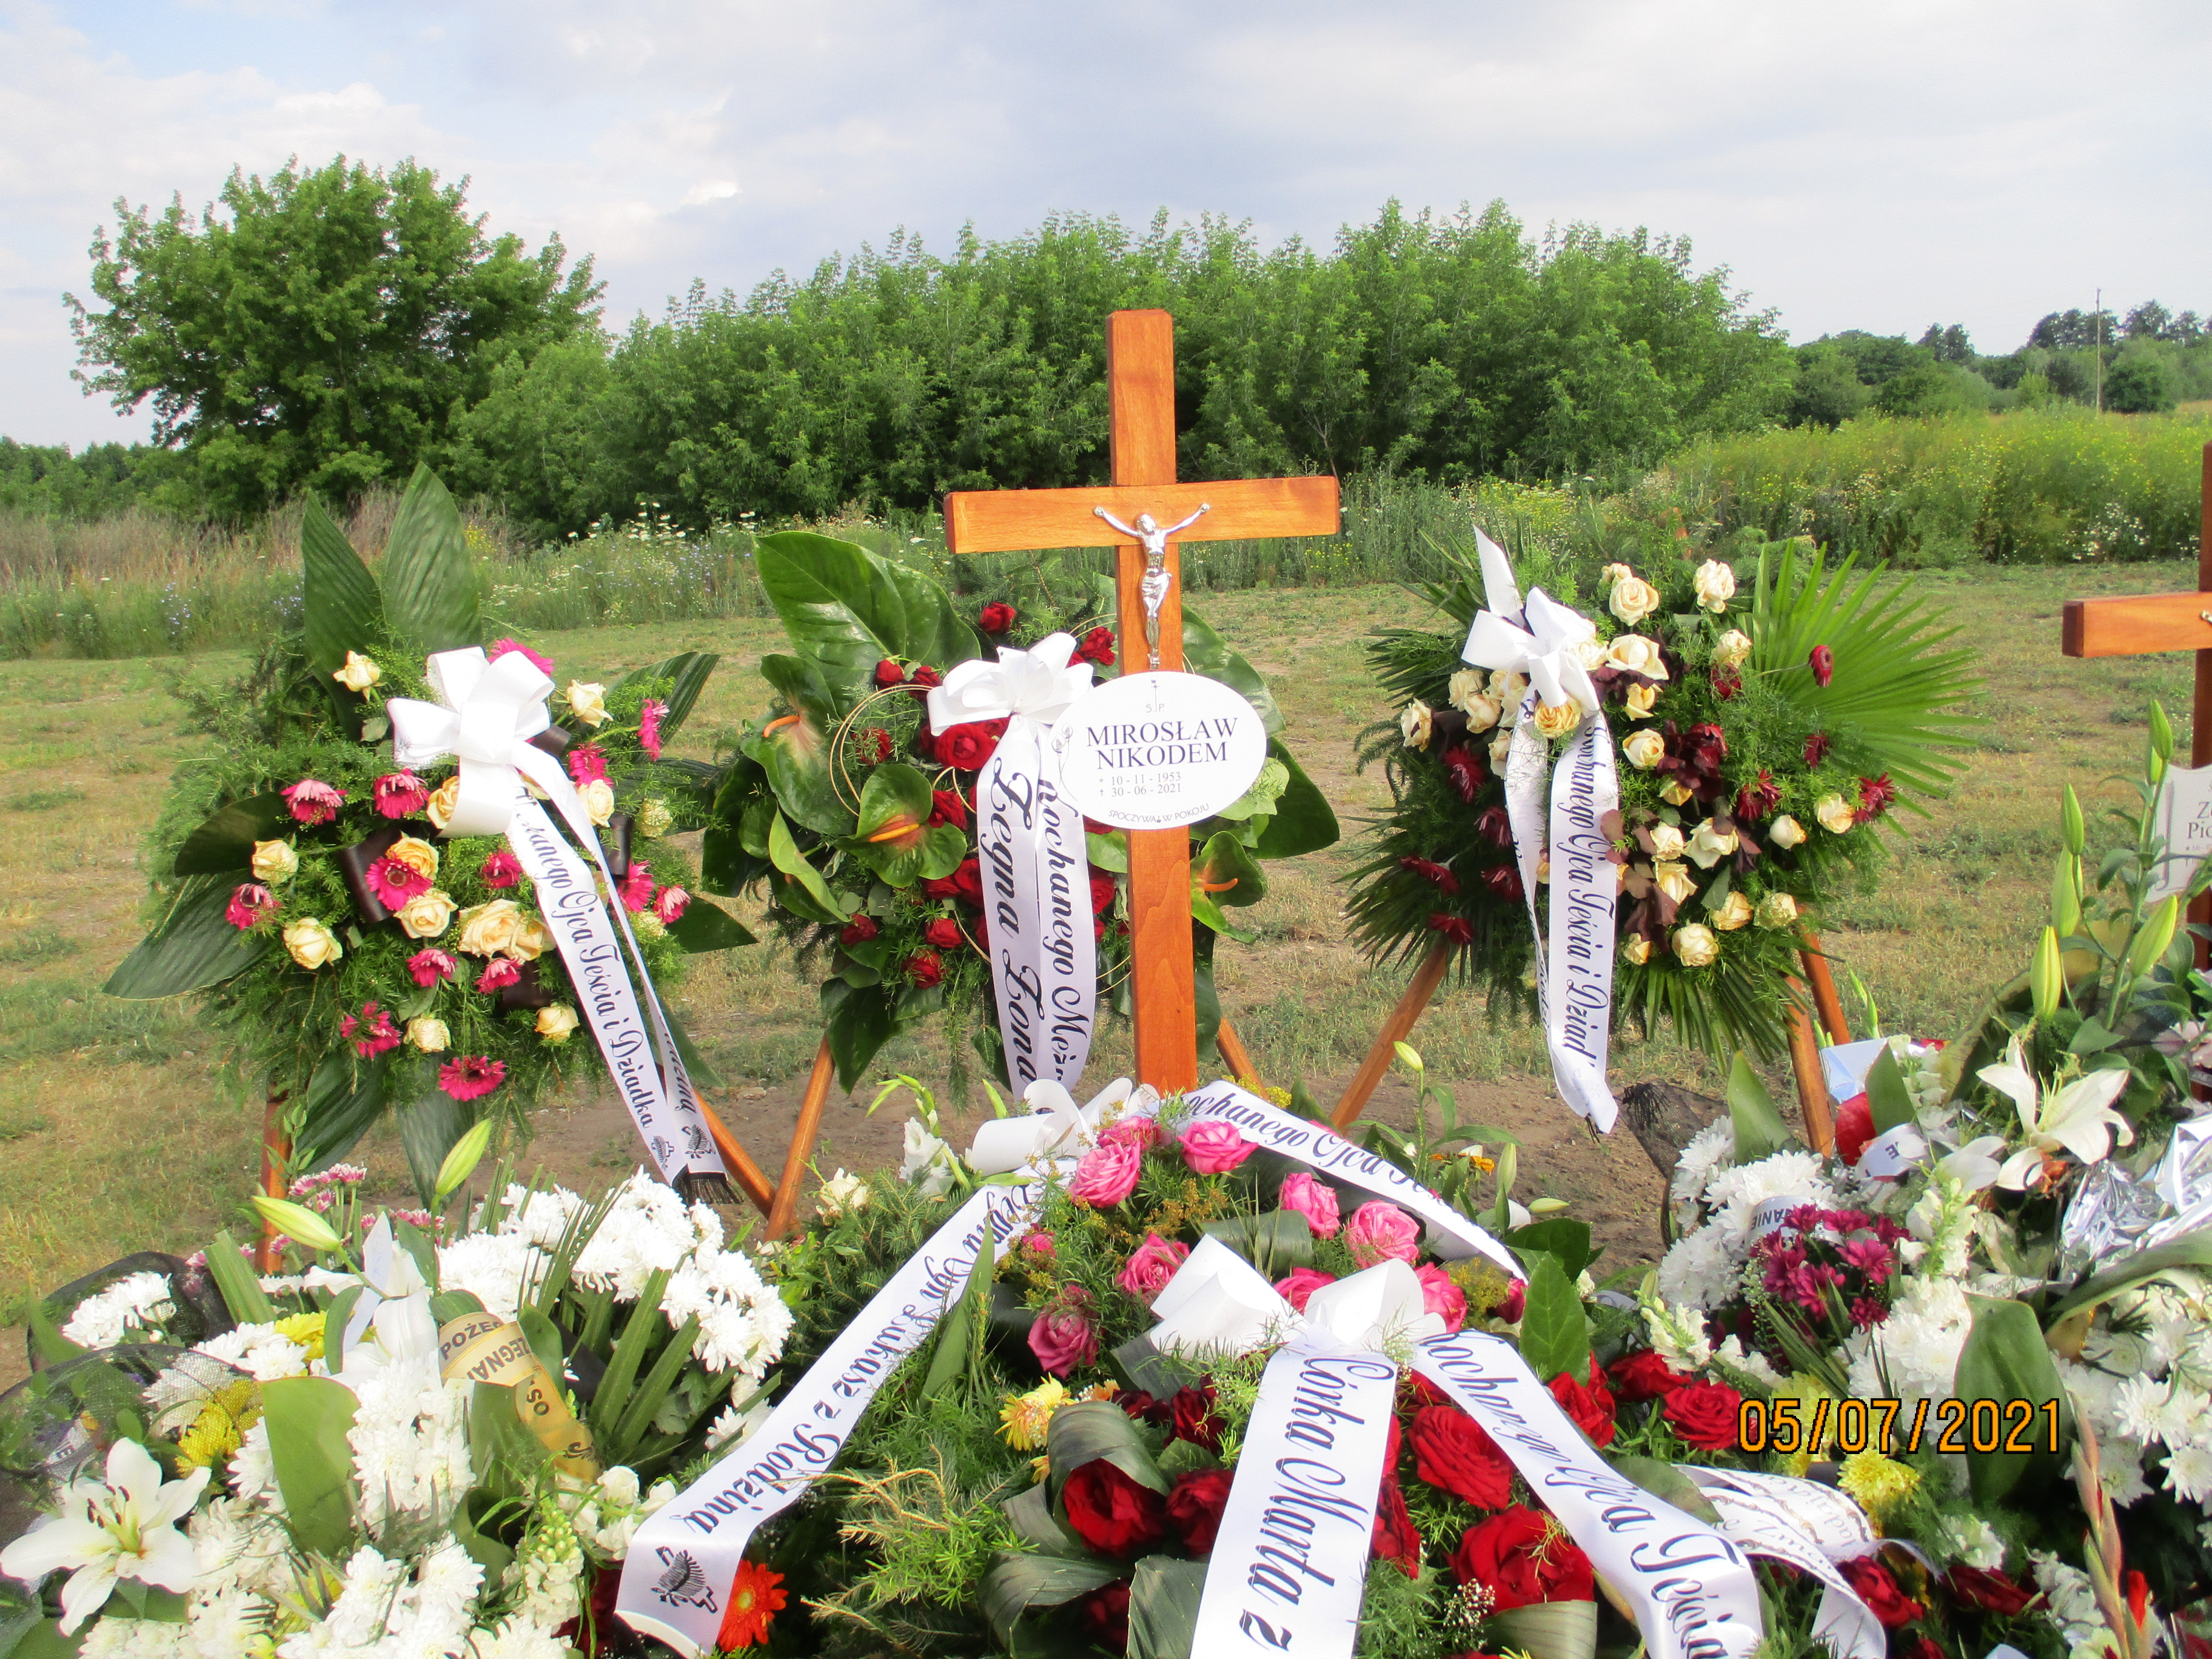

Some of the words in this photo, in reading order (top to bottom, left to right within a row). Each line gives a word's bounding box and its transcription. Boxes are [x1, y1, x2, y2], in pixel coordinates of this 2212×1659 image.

[1085, 717, 1238, 746] MIROSŁAW
[1095, 742, 1228, 769] NIKODEM
[1111, 776, 1123, 785] 10
[1134, 774, 1145, 784] 11
[1158, 771, 1181, 782] 1953
[1111, 787, 1124, 797] 30
[1134, 785, 1147, 796] 06
[1157, 783, 1181, 794] 2021
[1175, 803, 1209, 820] POKOJU
[1567, 888, 1615, 961] Teścia
[551, 891, 598, 943] Ojca
[580, 943, 622, 1017] Teścia
[608, 1030, 655, 1128] Dziadka
[813, 1399, 842, 1421] z
[1285, 1358, 1395, 1452] Córka
[1546, 1466, 1657, 1533] Ojca
[1247, 1458, 1369, 1606] Marta
[1239, 1609, 1292, 1651] z
